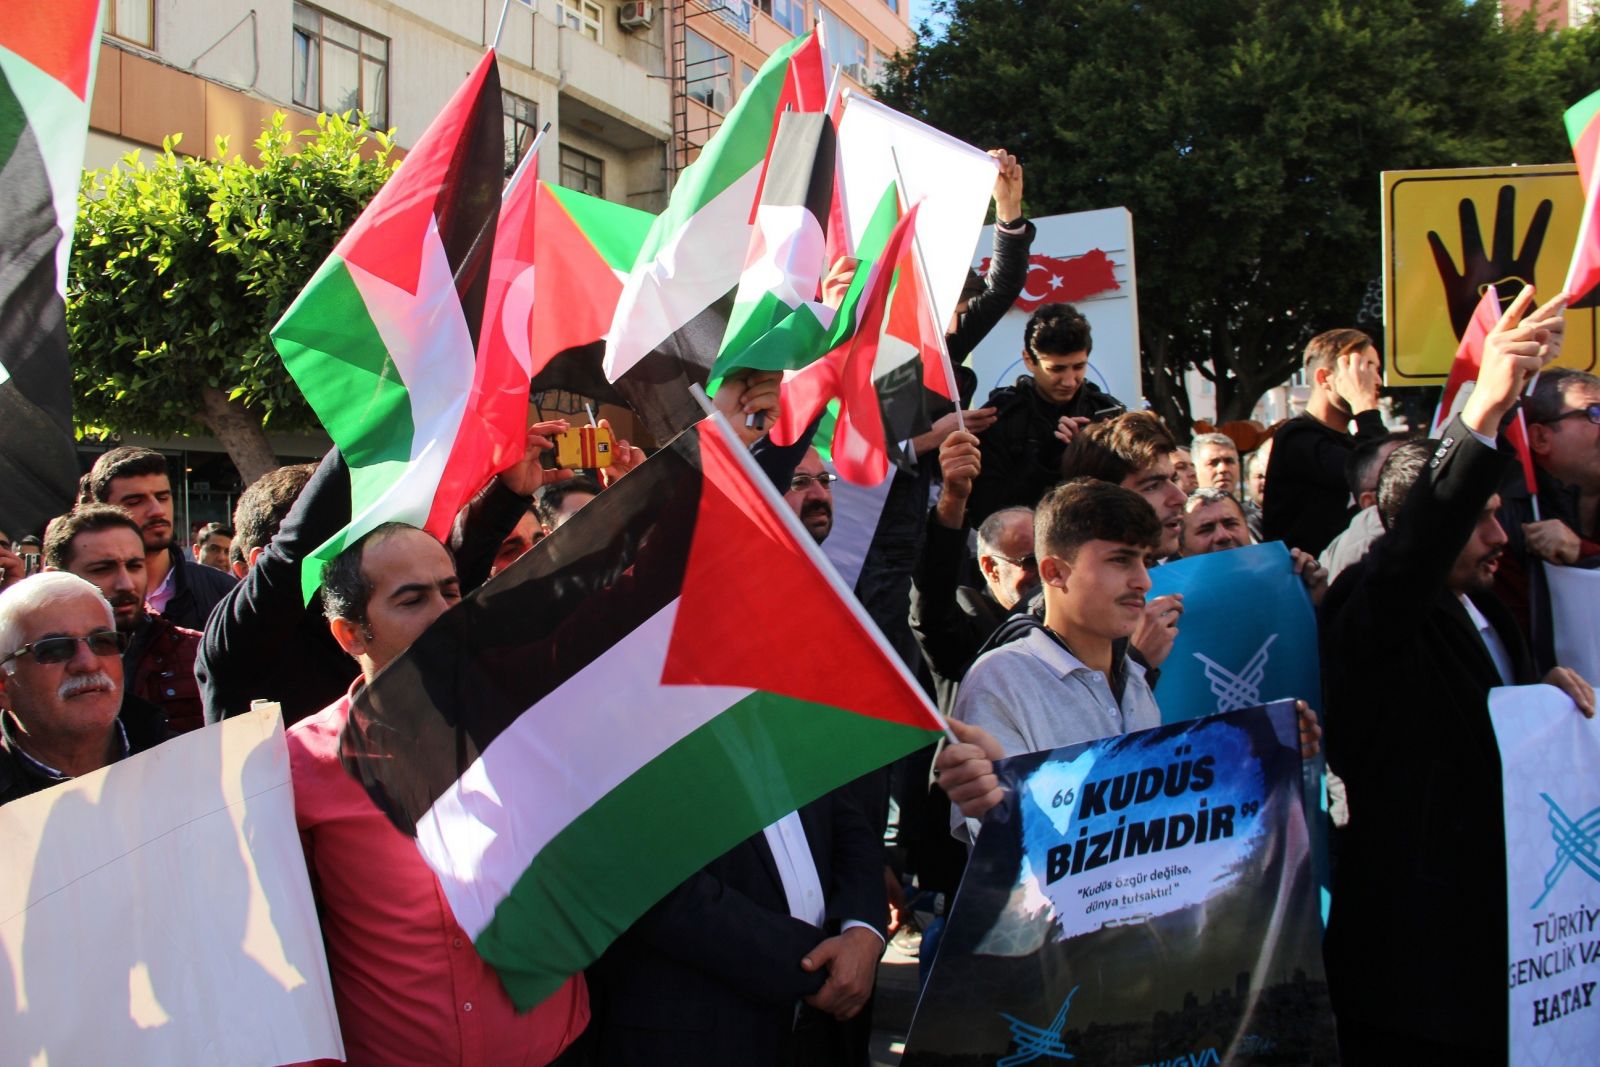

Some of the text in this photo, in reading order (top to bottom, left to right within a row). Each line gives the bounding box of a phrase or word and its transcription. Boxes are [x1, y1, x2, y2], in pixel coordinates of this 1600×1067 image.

[1115, 873, 1148, 888] özgür
[1149, 864, 1192, 881] değilse,
[1085, 899, 1119, 914] dünya
[1532, 981, 1597, 1027] HATAY
